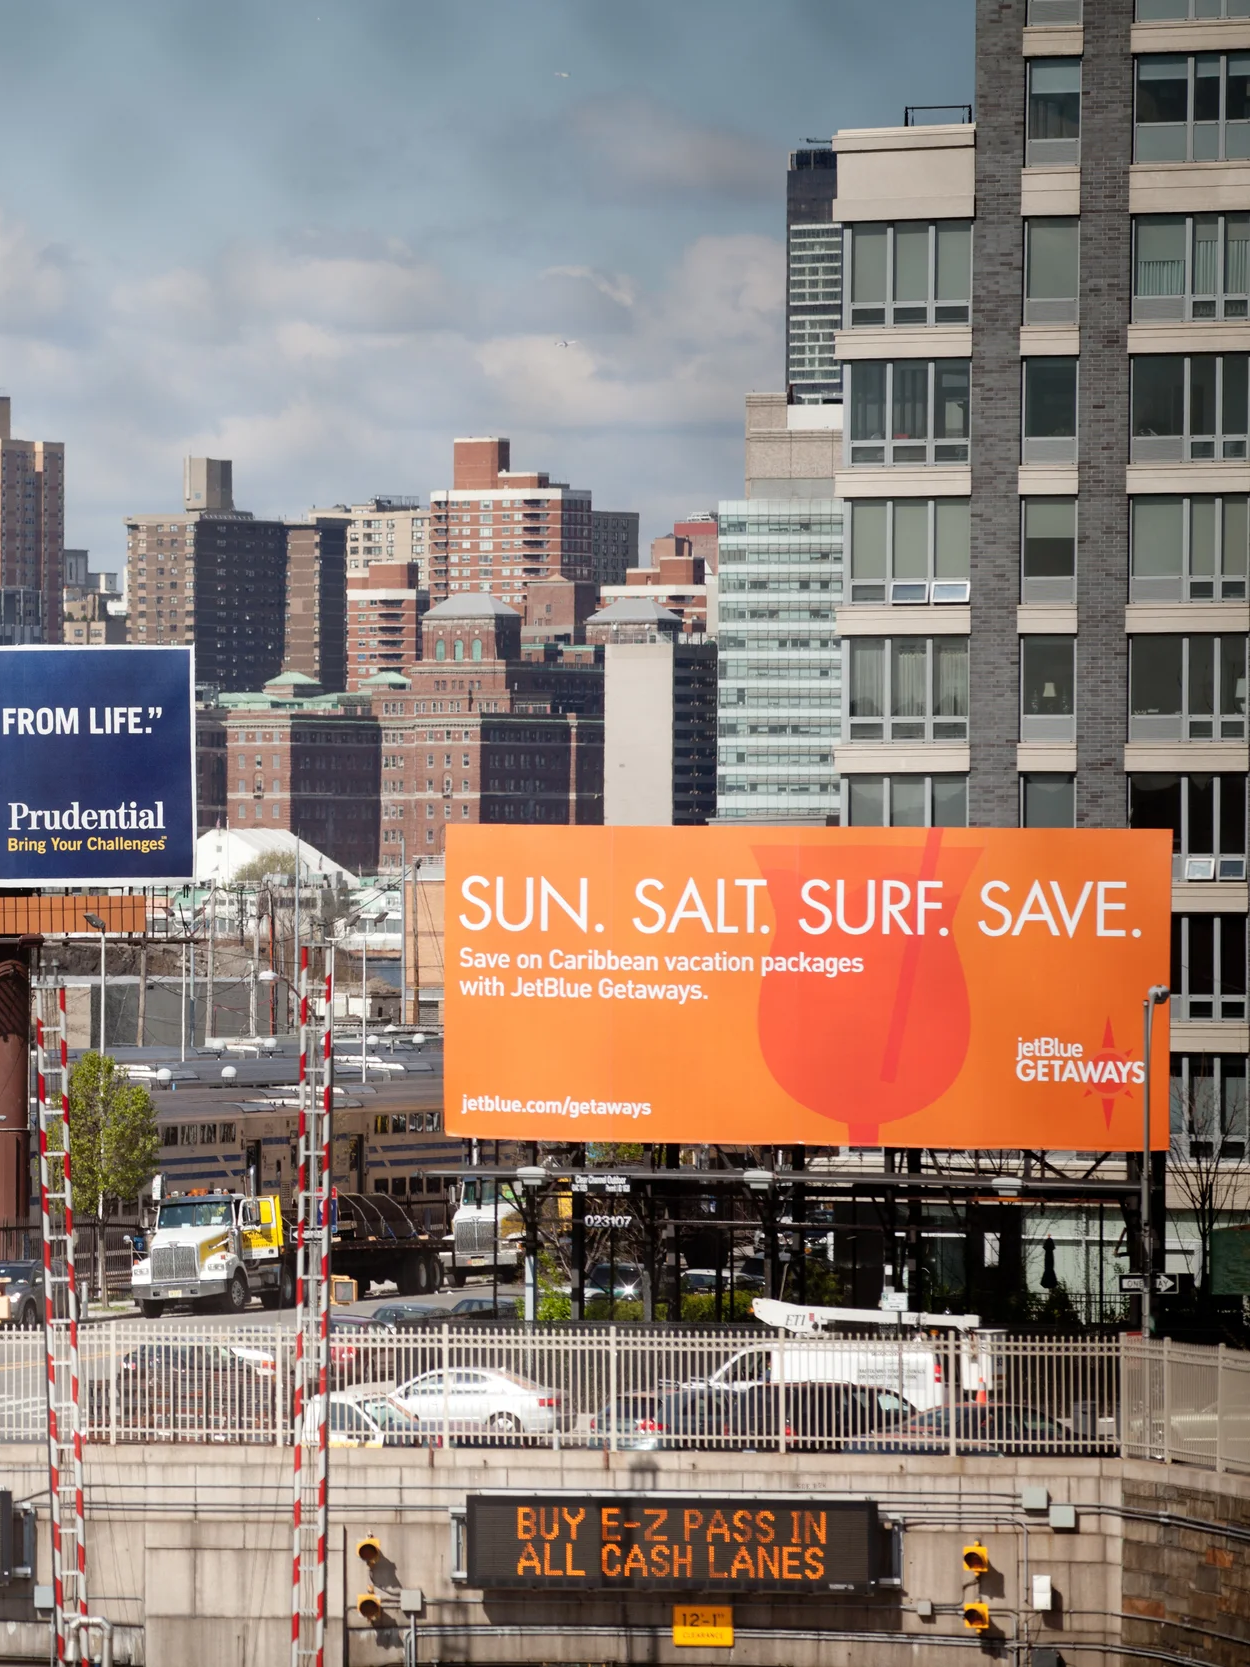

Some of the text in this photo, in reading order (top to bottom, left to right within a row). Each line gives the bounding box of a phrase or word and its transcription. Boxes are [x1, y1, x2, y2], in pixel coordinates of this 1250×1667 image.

[2, 707, 79, 735] FROM
[89, 706, 163, 734] LIFE.”
[7, 801, 166, 831] Prudential
[7, 837, 47, 854] Bring
[50, 837, 83, 852] Your
[459, 874, 1142, 939] SUN. SALT. SURF. SAVE.
[459, 947, 864, 978] Save on Caribbean vacation packages
[459, 976, 709, 1005] with JetBlue Getaways.
[1016, 1036, 1084, 1061] jetBlue
[1016, 1058, 1145, 1084] GETAWAYS
[461, 1094, 652, 1119] jetblue.com/getaways
[584, 1214, 632, 1228] 023107
[1127, 1279, 1169, 1288] ONE AY
[784, 1313, 806, 1327] ETI
[517, 1507, 827, 1544] BUY E-Z PASS IN
[516, 1543, 825, 1580] ALL CASH LANES
